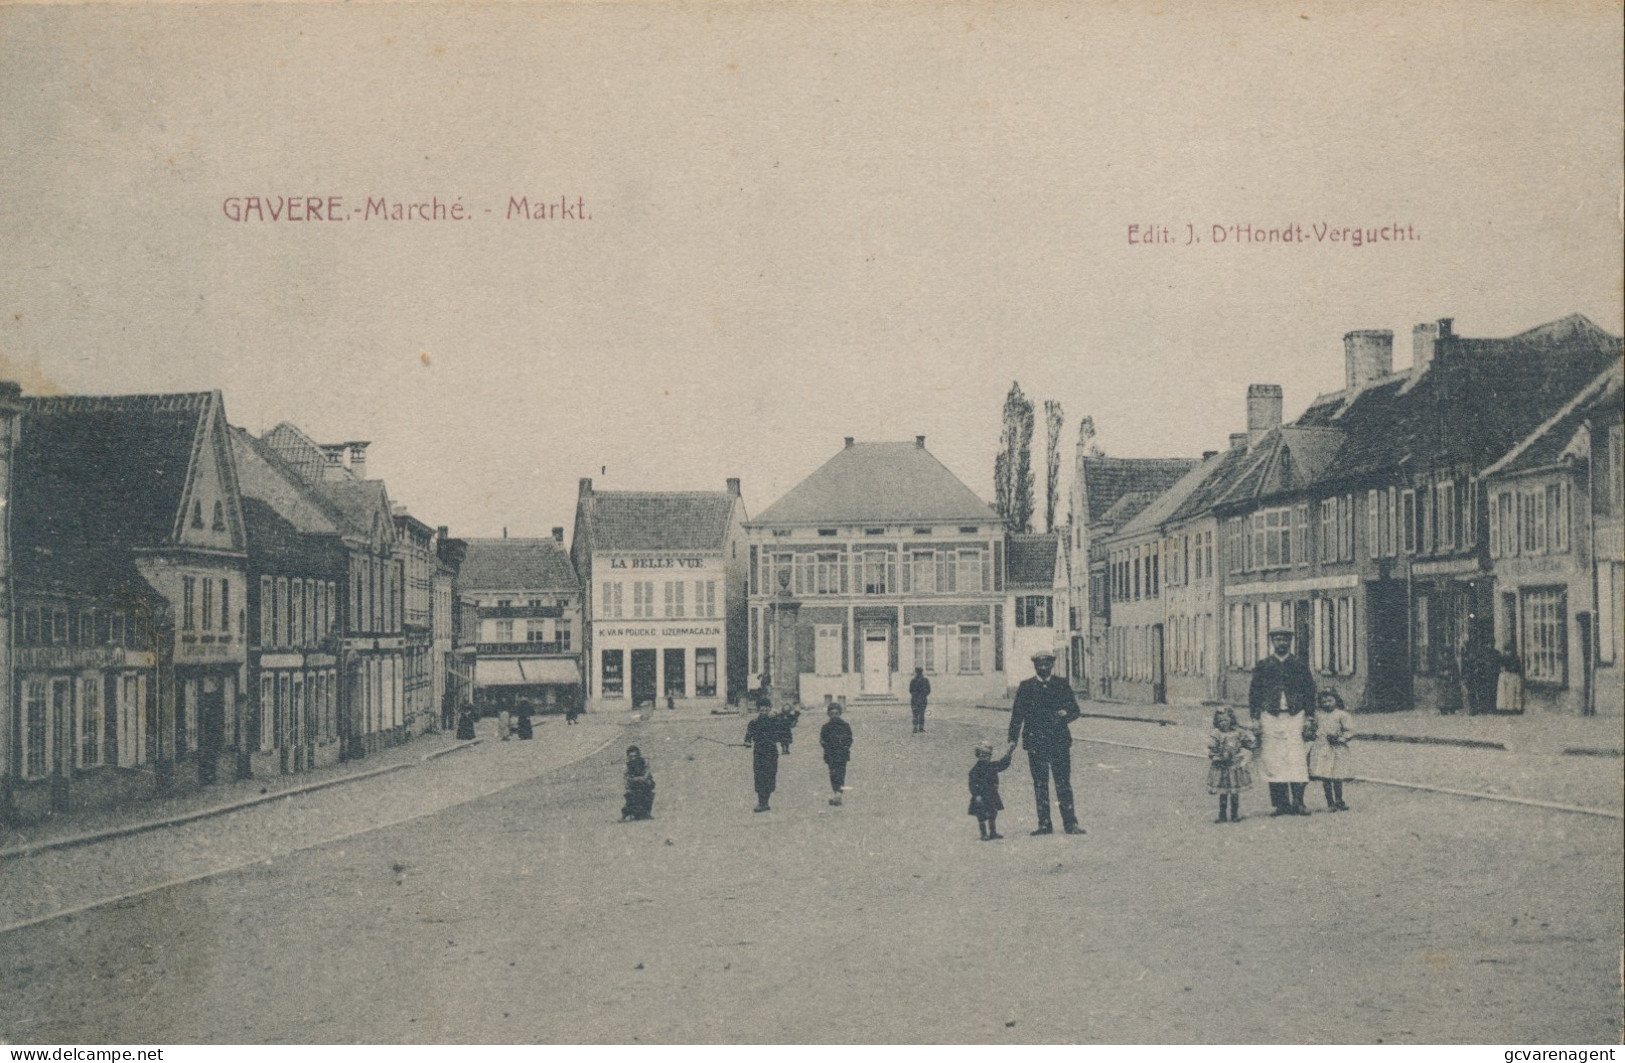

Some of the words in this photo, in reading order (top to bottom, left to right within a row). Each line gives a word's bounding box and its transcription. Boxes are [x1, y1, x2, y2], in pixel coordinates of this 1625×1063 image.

[611, 558, 627, 569] LA
[632, 558, 674, 569] BELLE
[607, 629, 623, 637] VAN
